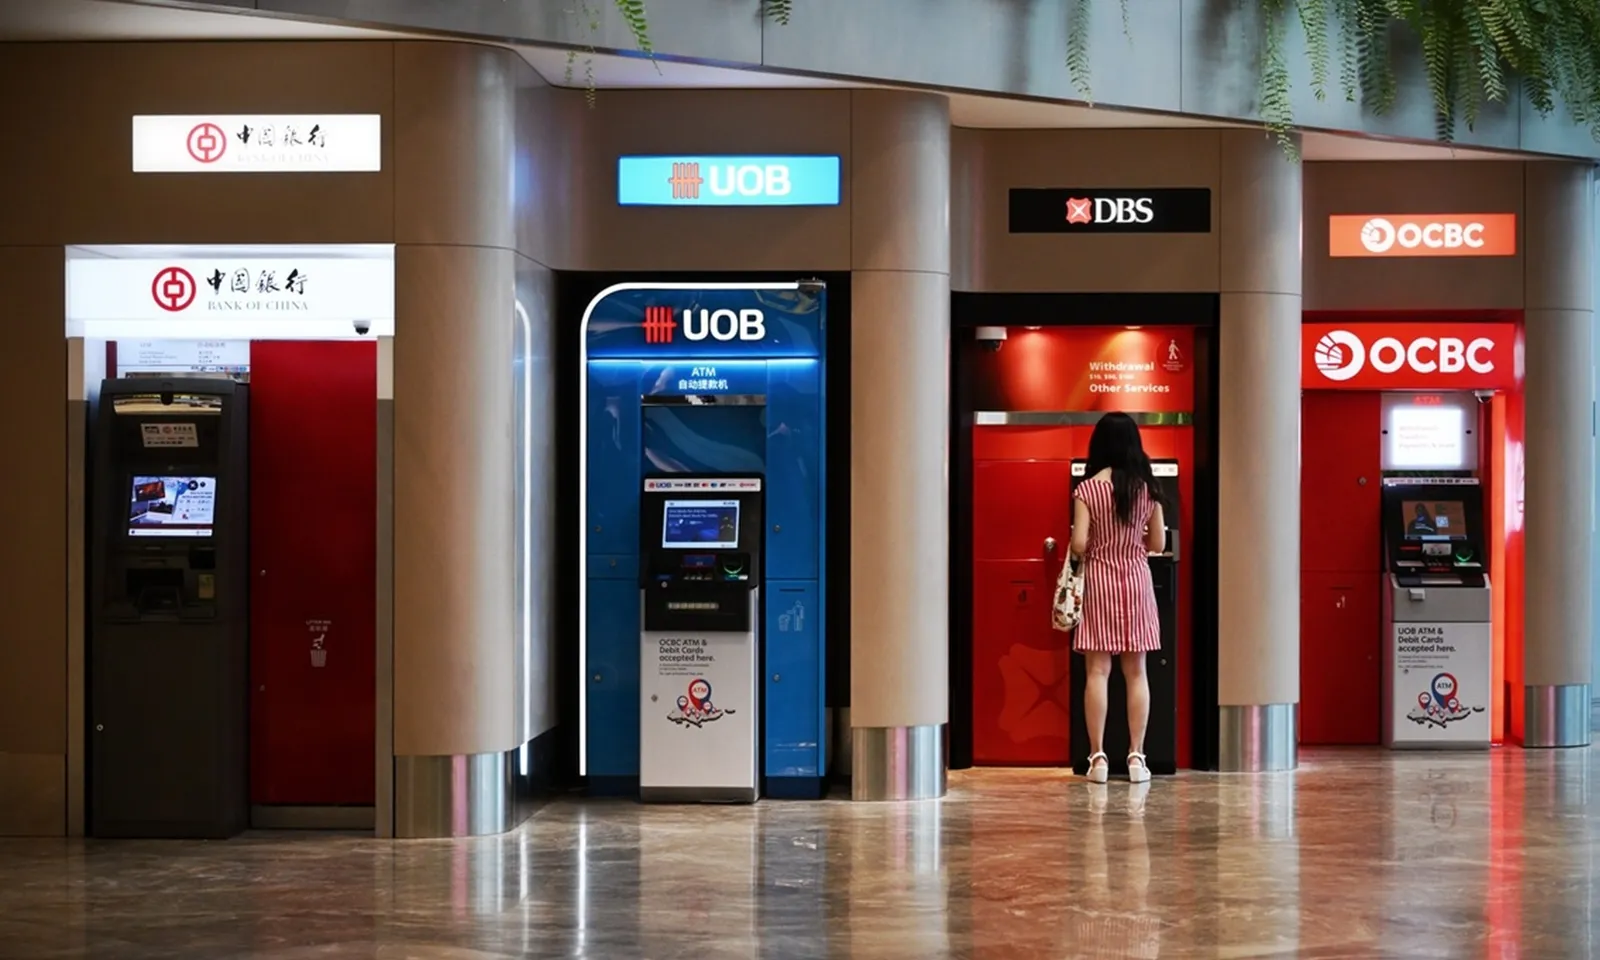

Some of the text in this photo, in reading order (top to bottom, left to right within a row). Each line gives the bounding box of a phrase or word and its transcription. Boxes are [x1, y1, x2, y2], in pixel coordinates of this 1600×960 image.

[709, 164, 792, 196] UOB
[1094, 198, 1154, 223] DBS
[1397, 223, 1485, 248] OCBC
[208, 301, 242, 310] BANK
[266, 301, 308, 310] CHINA
[683, 308, 766, 341] UOB
[1369, 337, 1496, 374] OCBC
[1089, 362, 1155, 371] Withdrawal
[691, 367, 716, 377] ATM
[1089, 383, 1170, 393] Other Services
[1398, 627, 1444, 635] UOB ATM &
[1398, 636, 1444, 644] Debit Cards
[1398, 645, 1435, 653] accepted
